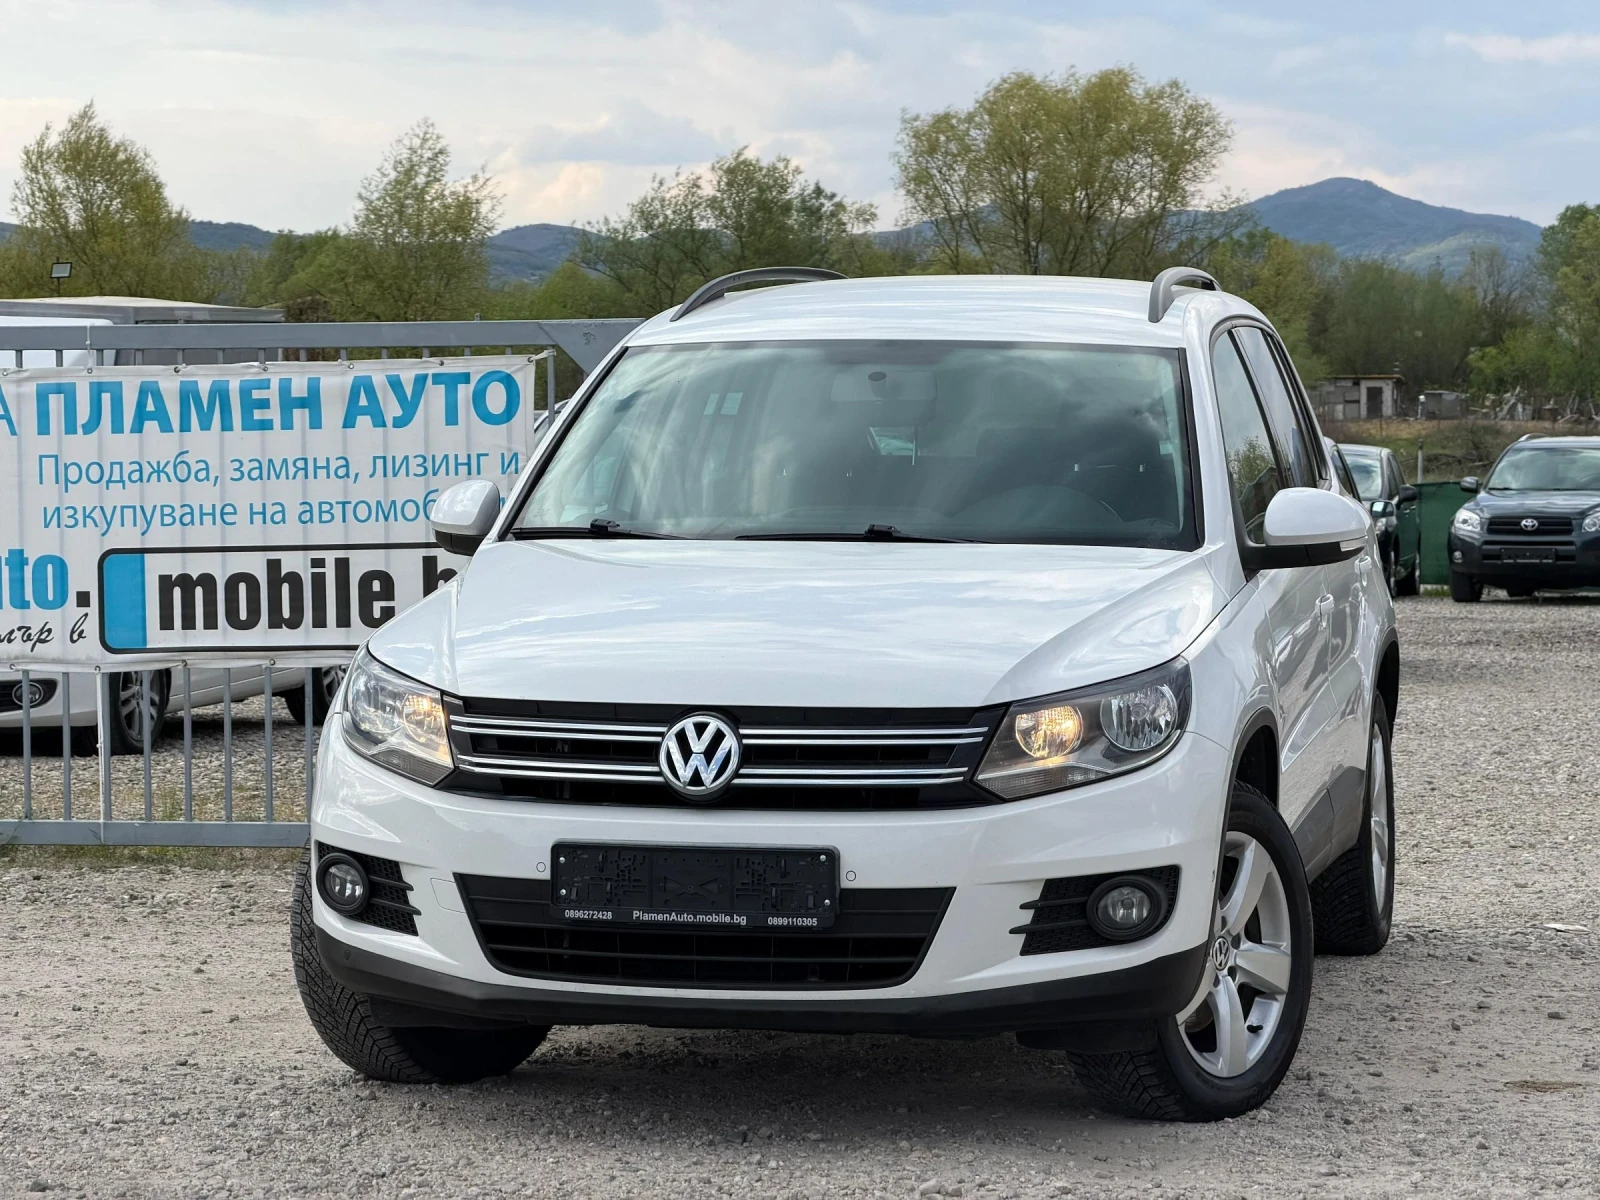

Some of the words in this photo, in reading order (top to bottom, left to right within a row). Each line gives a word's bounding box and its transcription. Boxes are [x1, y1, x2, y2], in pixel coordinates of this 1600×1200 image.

[35, 376, 324, 436] ПЛАМЕН
[341, 370, 521, 430] АУТО
[38, 449, 220, 493] Продажба,
[230, 455, 360, 485] замяна,
[369, 451, 489, 480] лизинг
[500, 451, 520, 476] и
[43, 501, 238, 537] изкупуване
[249, 502, 287, 526] на
[298, 488, 506, 526] автомоб
[564, 909, 613, 921] 0896272428
[632, 910, 747, 926] PlamenAuto.mobile.bg
[767, 915, 818, 927] 0899110305
